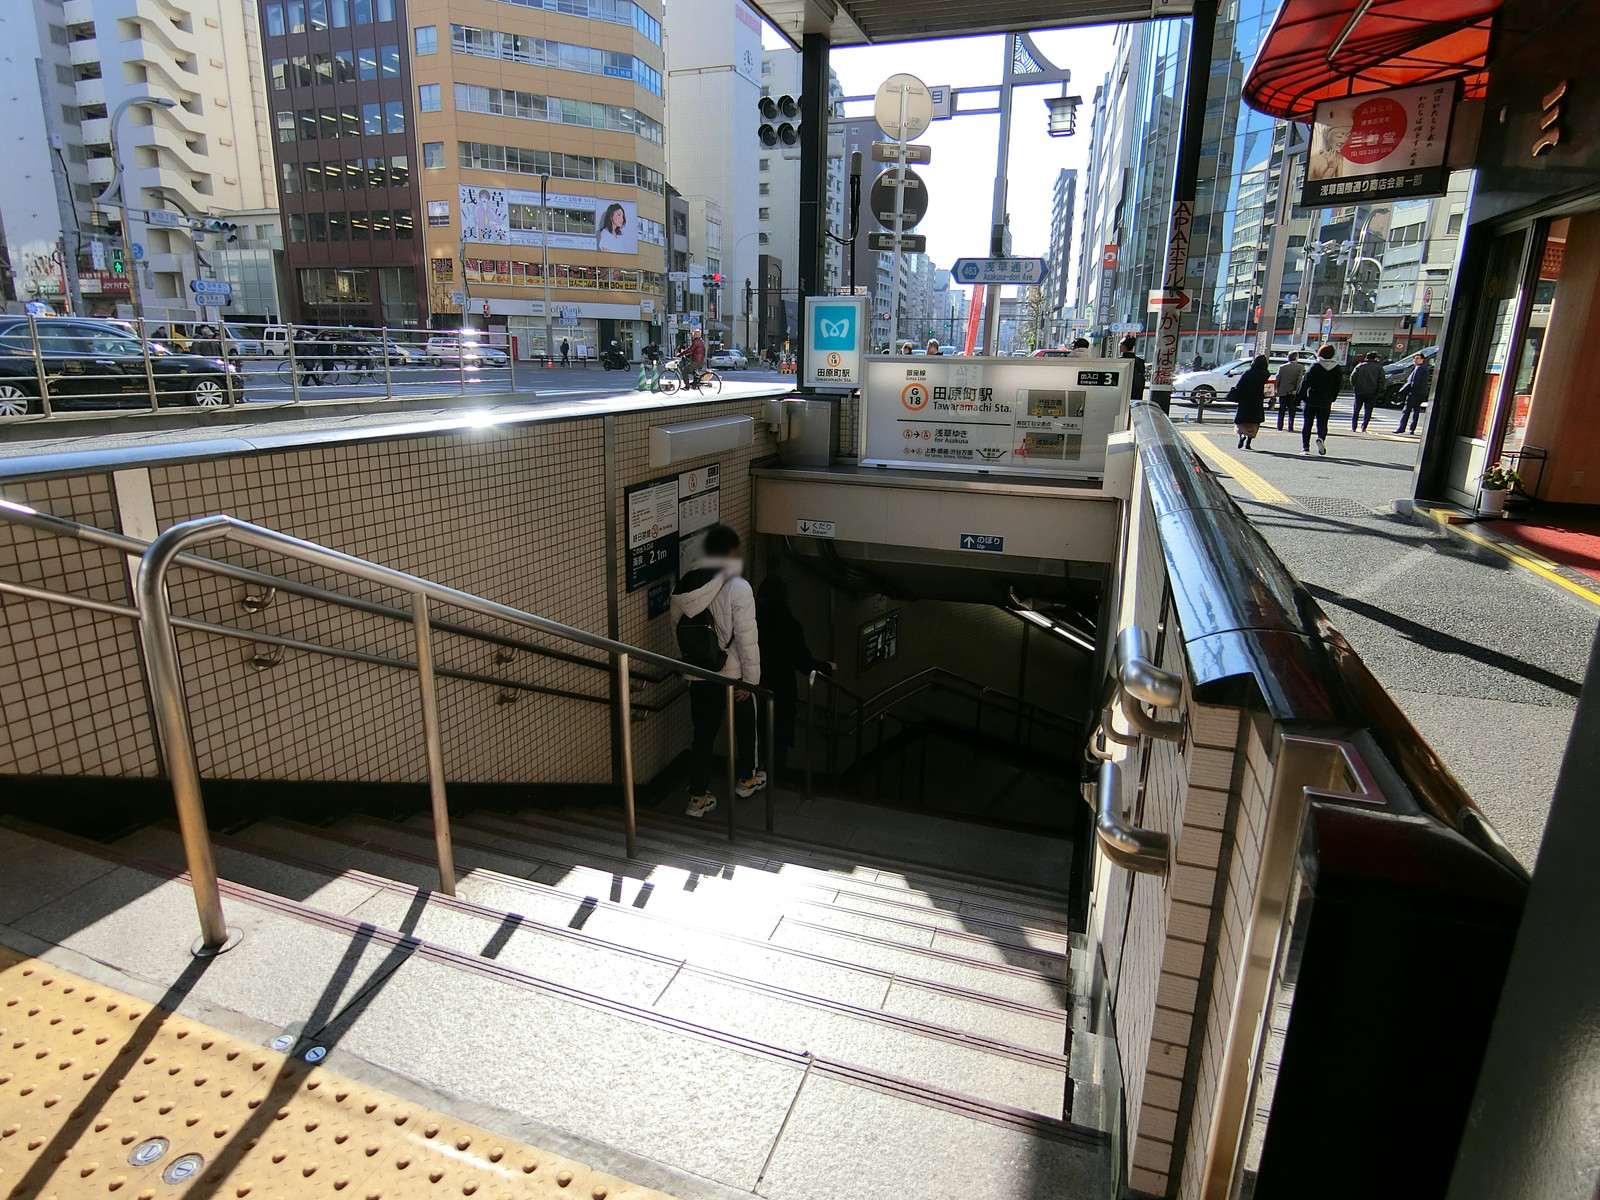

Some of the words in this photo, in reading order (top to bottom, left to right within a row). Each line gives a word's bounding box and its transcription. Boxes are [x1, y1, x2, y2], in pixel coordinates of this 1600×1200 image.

[1319, 173, 1423, 197] 浅草国際通り商店会第一部
[462, 188, 505, 207] 浅草
[463, 226, 508, 240] 美容室
[1165, 202, 1191, 287] APAホテル
[964, 266, 977, 276] 463
[984, 261, 1034, 273] 浅草通り
[983, 273, 1020, 281] Asakusa-dori
[1022, 273, 1034, 281] Ave.
[1099, 269, 1114, 324] 朝日信用金庫
[550, 304, 583, 315] oftBank
[1153, 312, 1178, 385] かっぱ橋
[817, 368, 851, 378] 田原町駅
[906, 369, 927, 377] 銀座線
[1104, 373, 1112, 385] 3
[911, 387, 919, 395] G
[933, 386, 993, 402] 田原町駅
[909, 396, 921, 405] 18
[933, 401, 992, 412] Tawaramachi
[994, 403, 1012, 413] Sta.
[935, 429, 968, 438] 浅草ゆき
[812, 521, 832, 530] くだり
[976, 536, 1001, 544] のぼり
[632, 543, 654, 556] この出入口は
[649, 549, 667, 565] 2.1m
